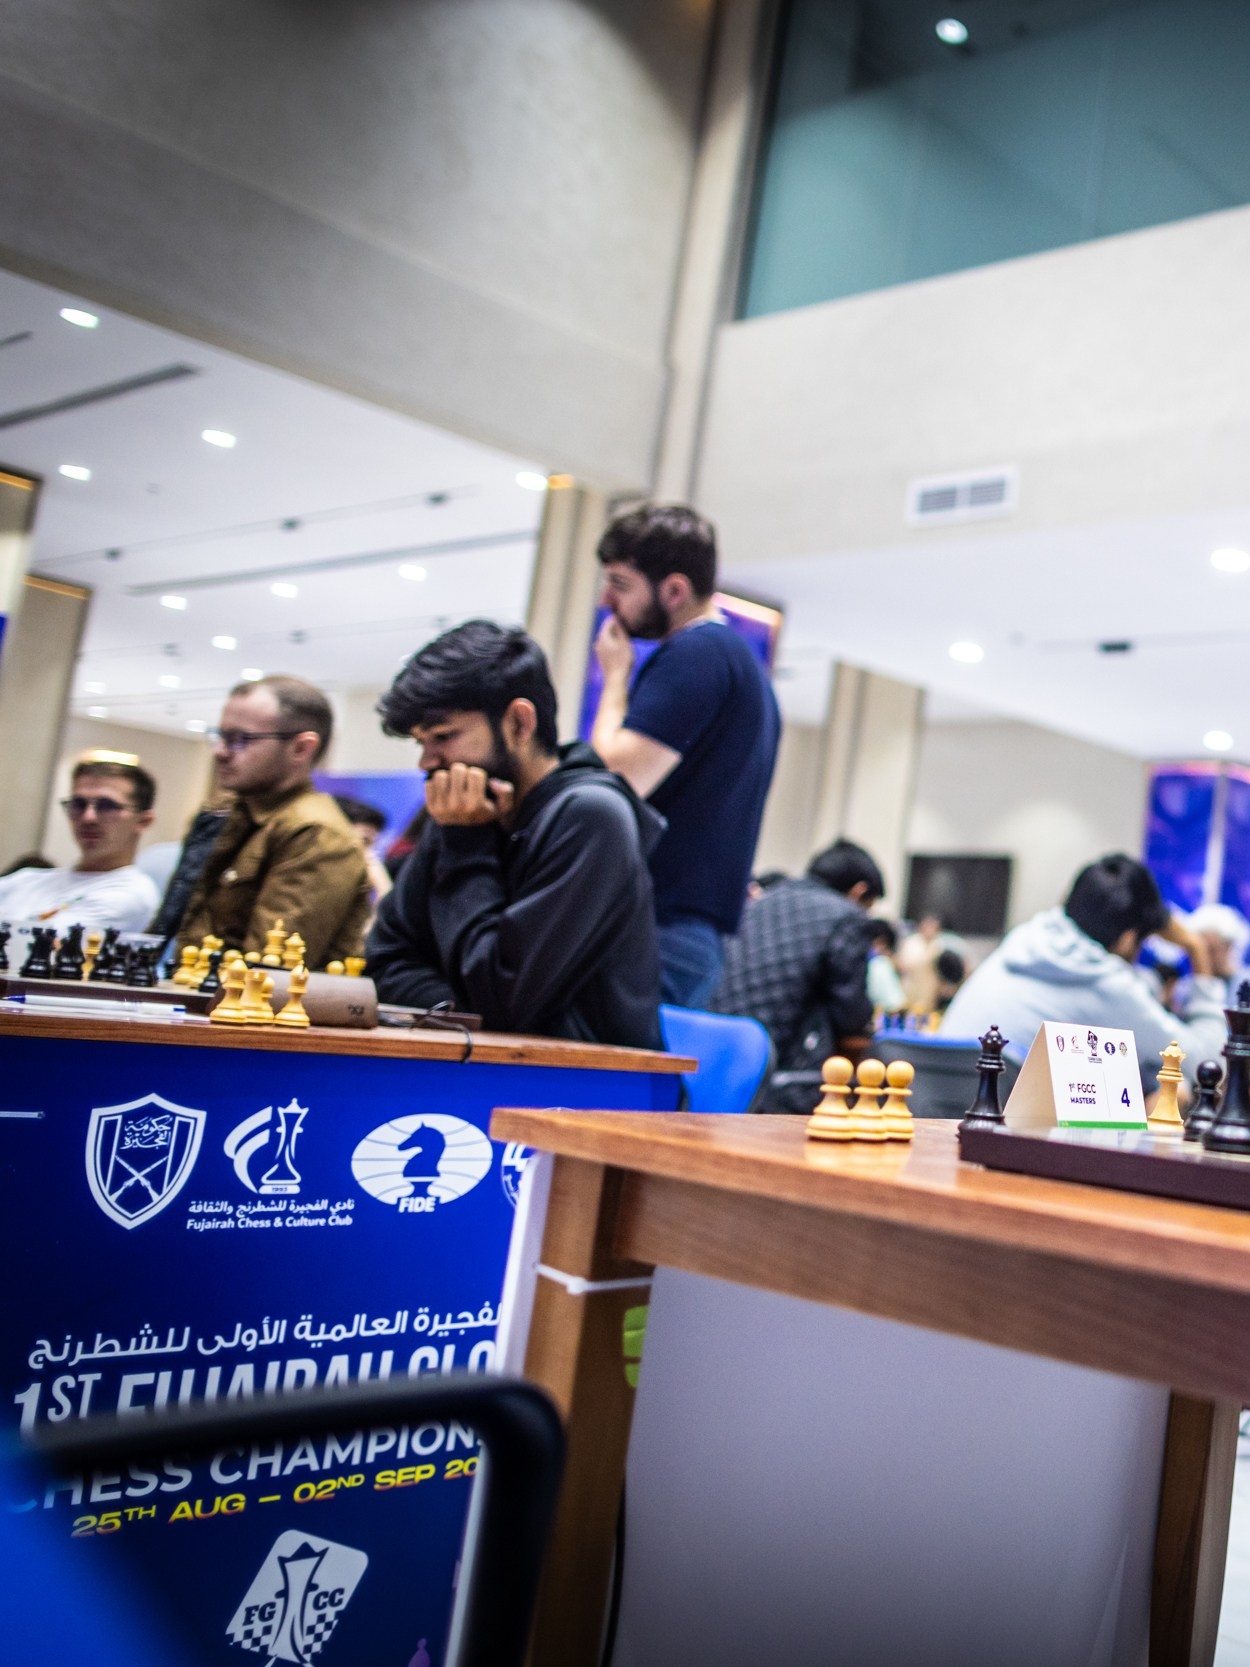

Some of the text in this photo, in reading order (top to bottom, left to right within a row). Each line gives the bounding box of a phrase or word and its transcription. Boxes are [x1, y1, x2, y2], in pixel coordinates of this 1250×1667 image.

[1070, 1097, 1096, 1105] MASTERS
[1077, 1083, 1096, 1094] FGCC
[1121, 1087, 1131, 1108] 4
[188, 1198, 355, 1218] نادي الفجيرة للشطرنج والثقافة
[398, 1196, 437, 1213] FIDE
[186, 1214, 353, 1232] Fujairah Chess & Culture Club
[197, 1316, 287, 1356] الأولى
[293, 1310, 409, 1349] العالمية
[28, 1323, 190, 1370] للشطرنج
[14, 1372, 102, 1435] 1ST
[7, 1420, 484, 1513] HESS CHAMPION
[71, 1505, 157, 1538] 25TH
[168, 1493, 247, 1524] AUG
[294, 1474, 365, 1503] 02ND
[374, 1464, 436, 1491] SEP
[312, 1588, 345, 1611] CC
[242, 1602, 277, 1626] FG
